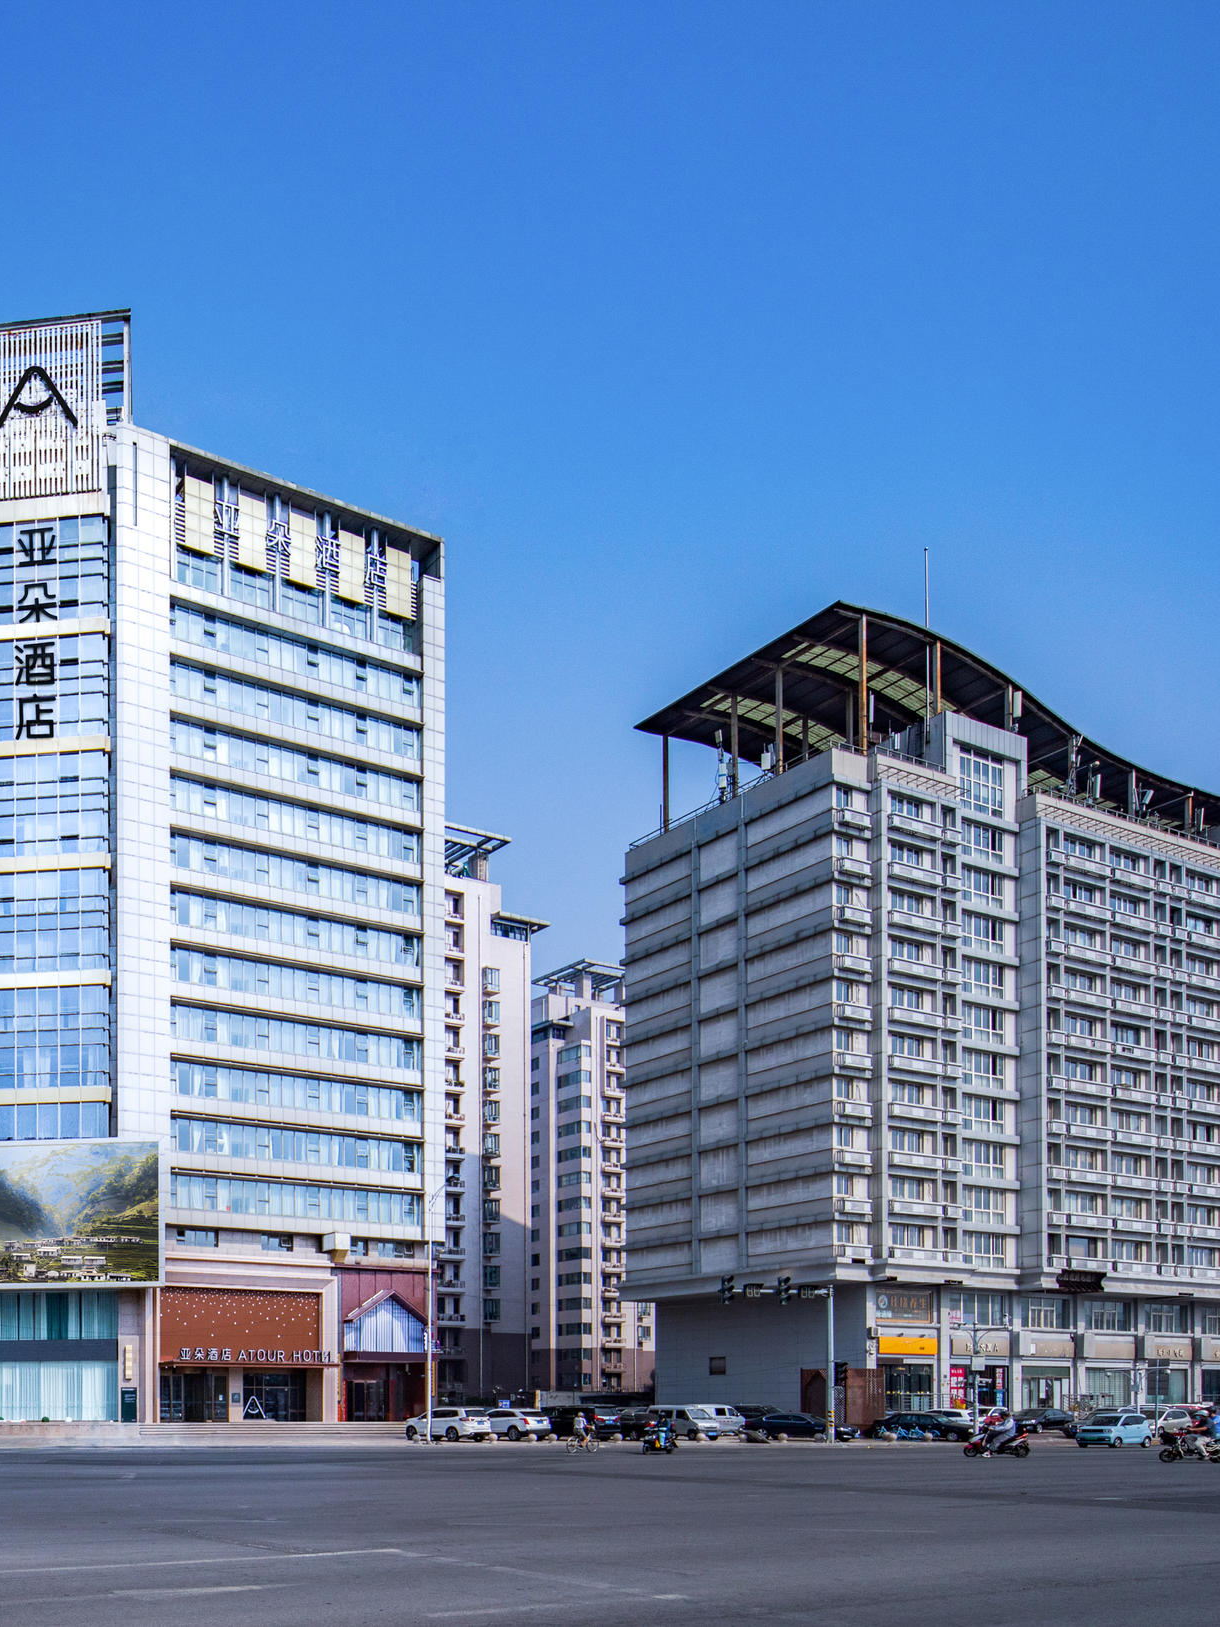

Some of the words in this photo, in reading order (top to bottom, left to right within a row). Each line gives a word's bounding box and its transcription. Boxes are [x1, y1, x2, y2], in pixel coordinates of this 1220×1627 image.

[214, 500, 388, 590] 亚朵酒店
[15, 526, 57, 740] 亚朵酒店
[180, 1347, 232, 1361] 亚朵酒店
[238, 1349, 285, 1362] ATOUR
[291, 1350, 331, 1362] HOT
